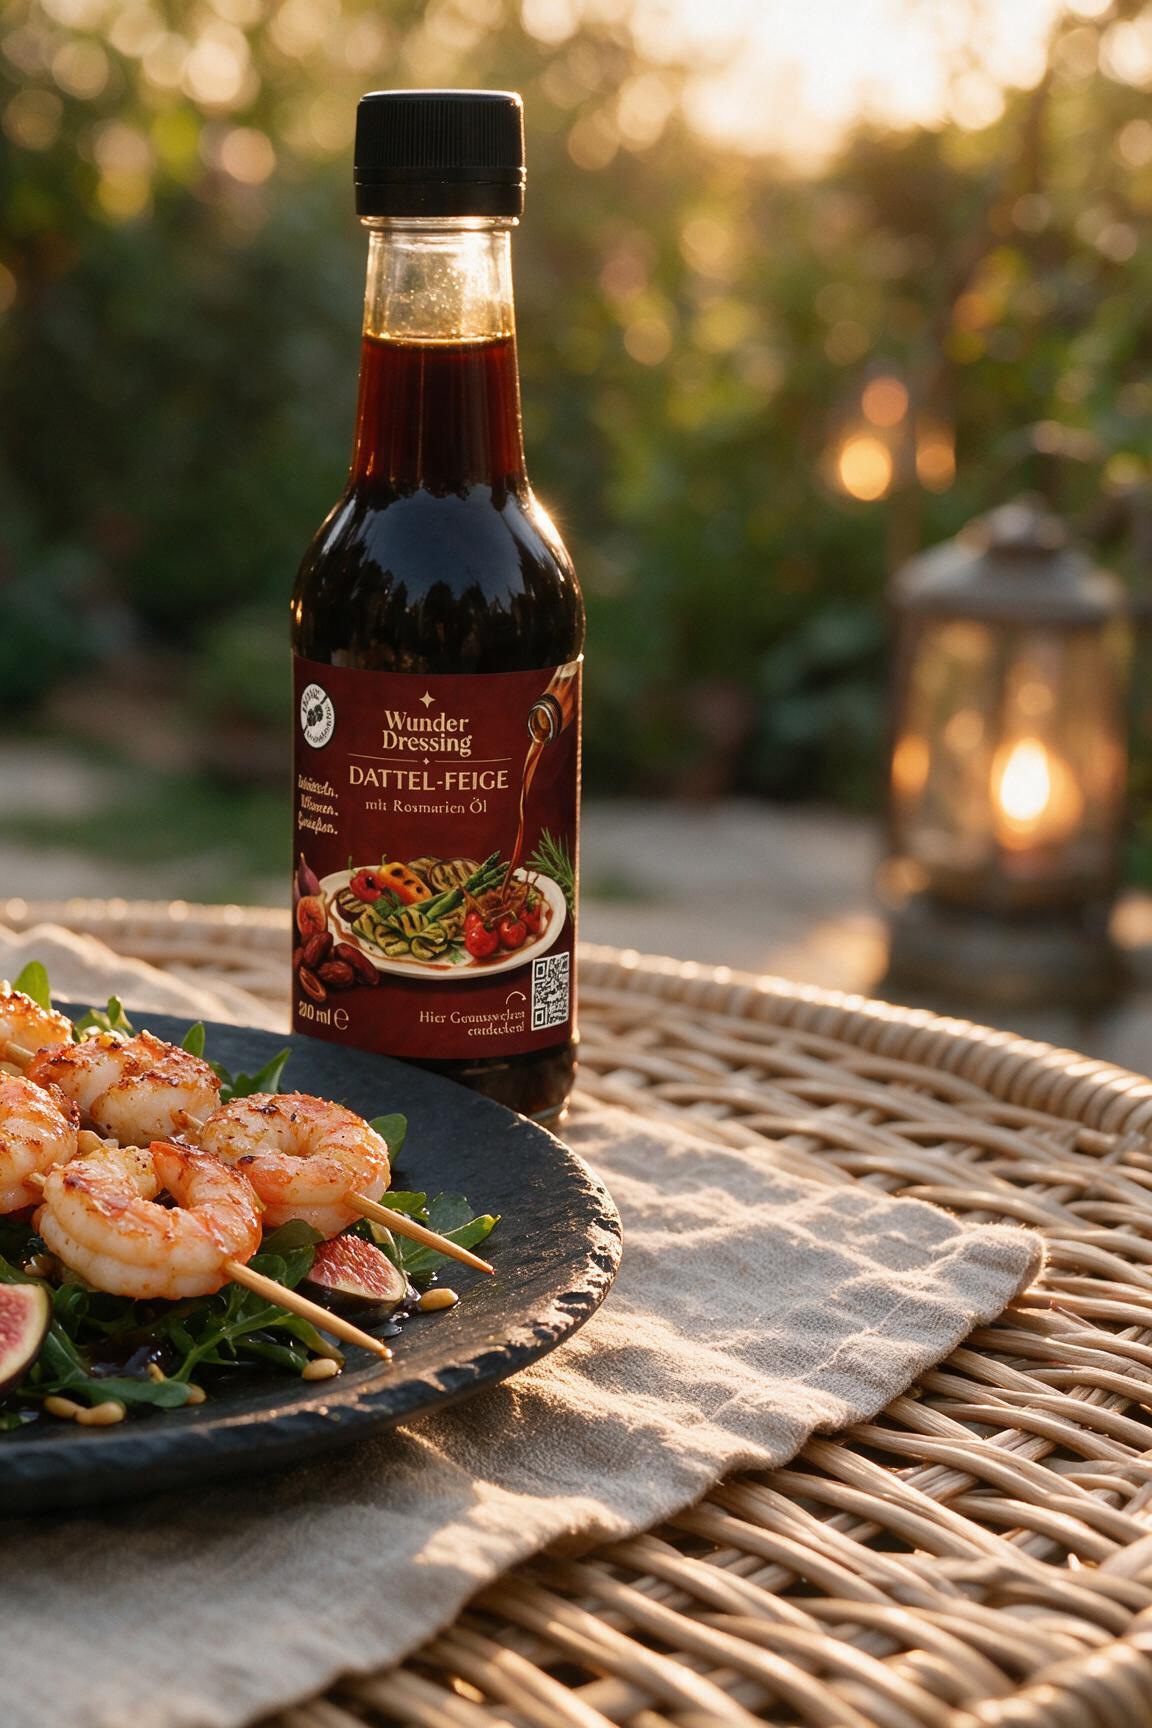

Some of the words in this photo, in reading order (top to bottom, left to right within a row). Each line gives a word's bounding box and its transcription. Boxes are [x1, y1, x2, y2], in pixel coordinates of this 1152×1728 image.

[385, 710, 469, 733] Wunder
[382, 730, 473, 757] Dressing
[349, 765, 509, 791] DATTEL-FEIGE
[469, 797, 487, 814] Öl
[315, 1006, 331, 1025] ml
[419, 1010, 445, 1023] Hier
